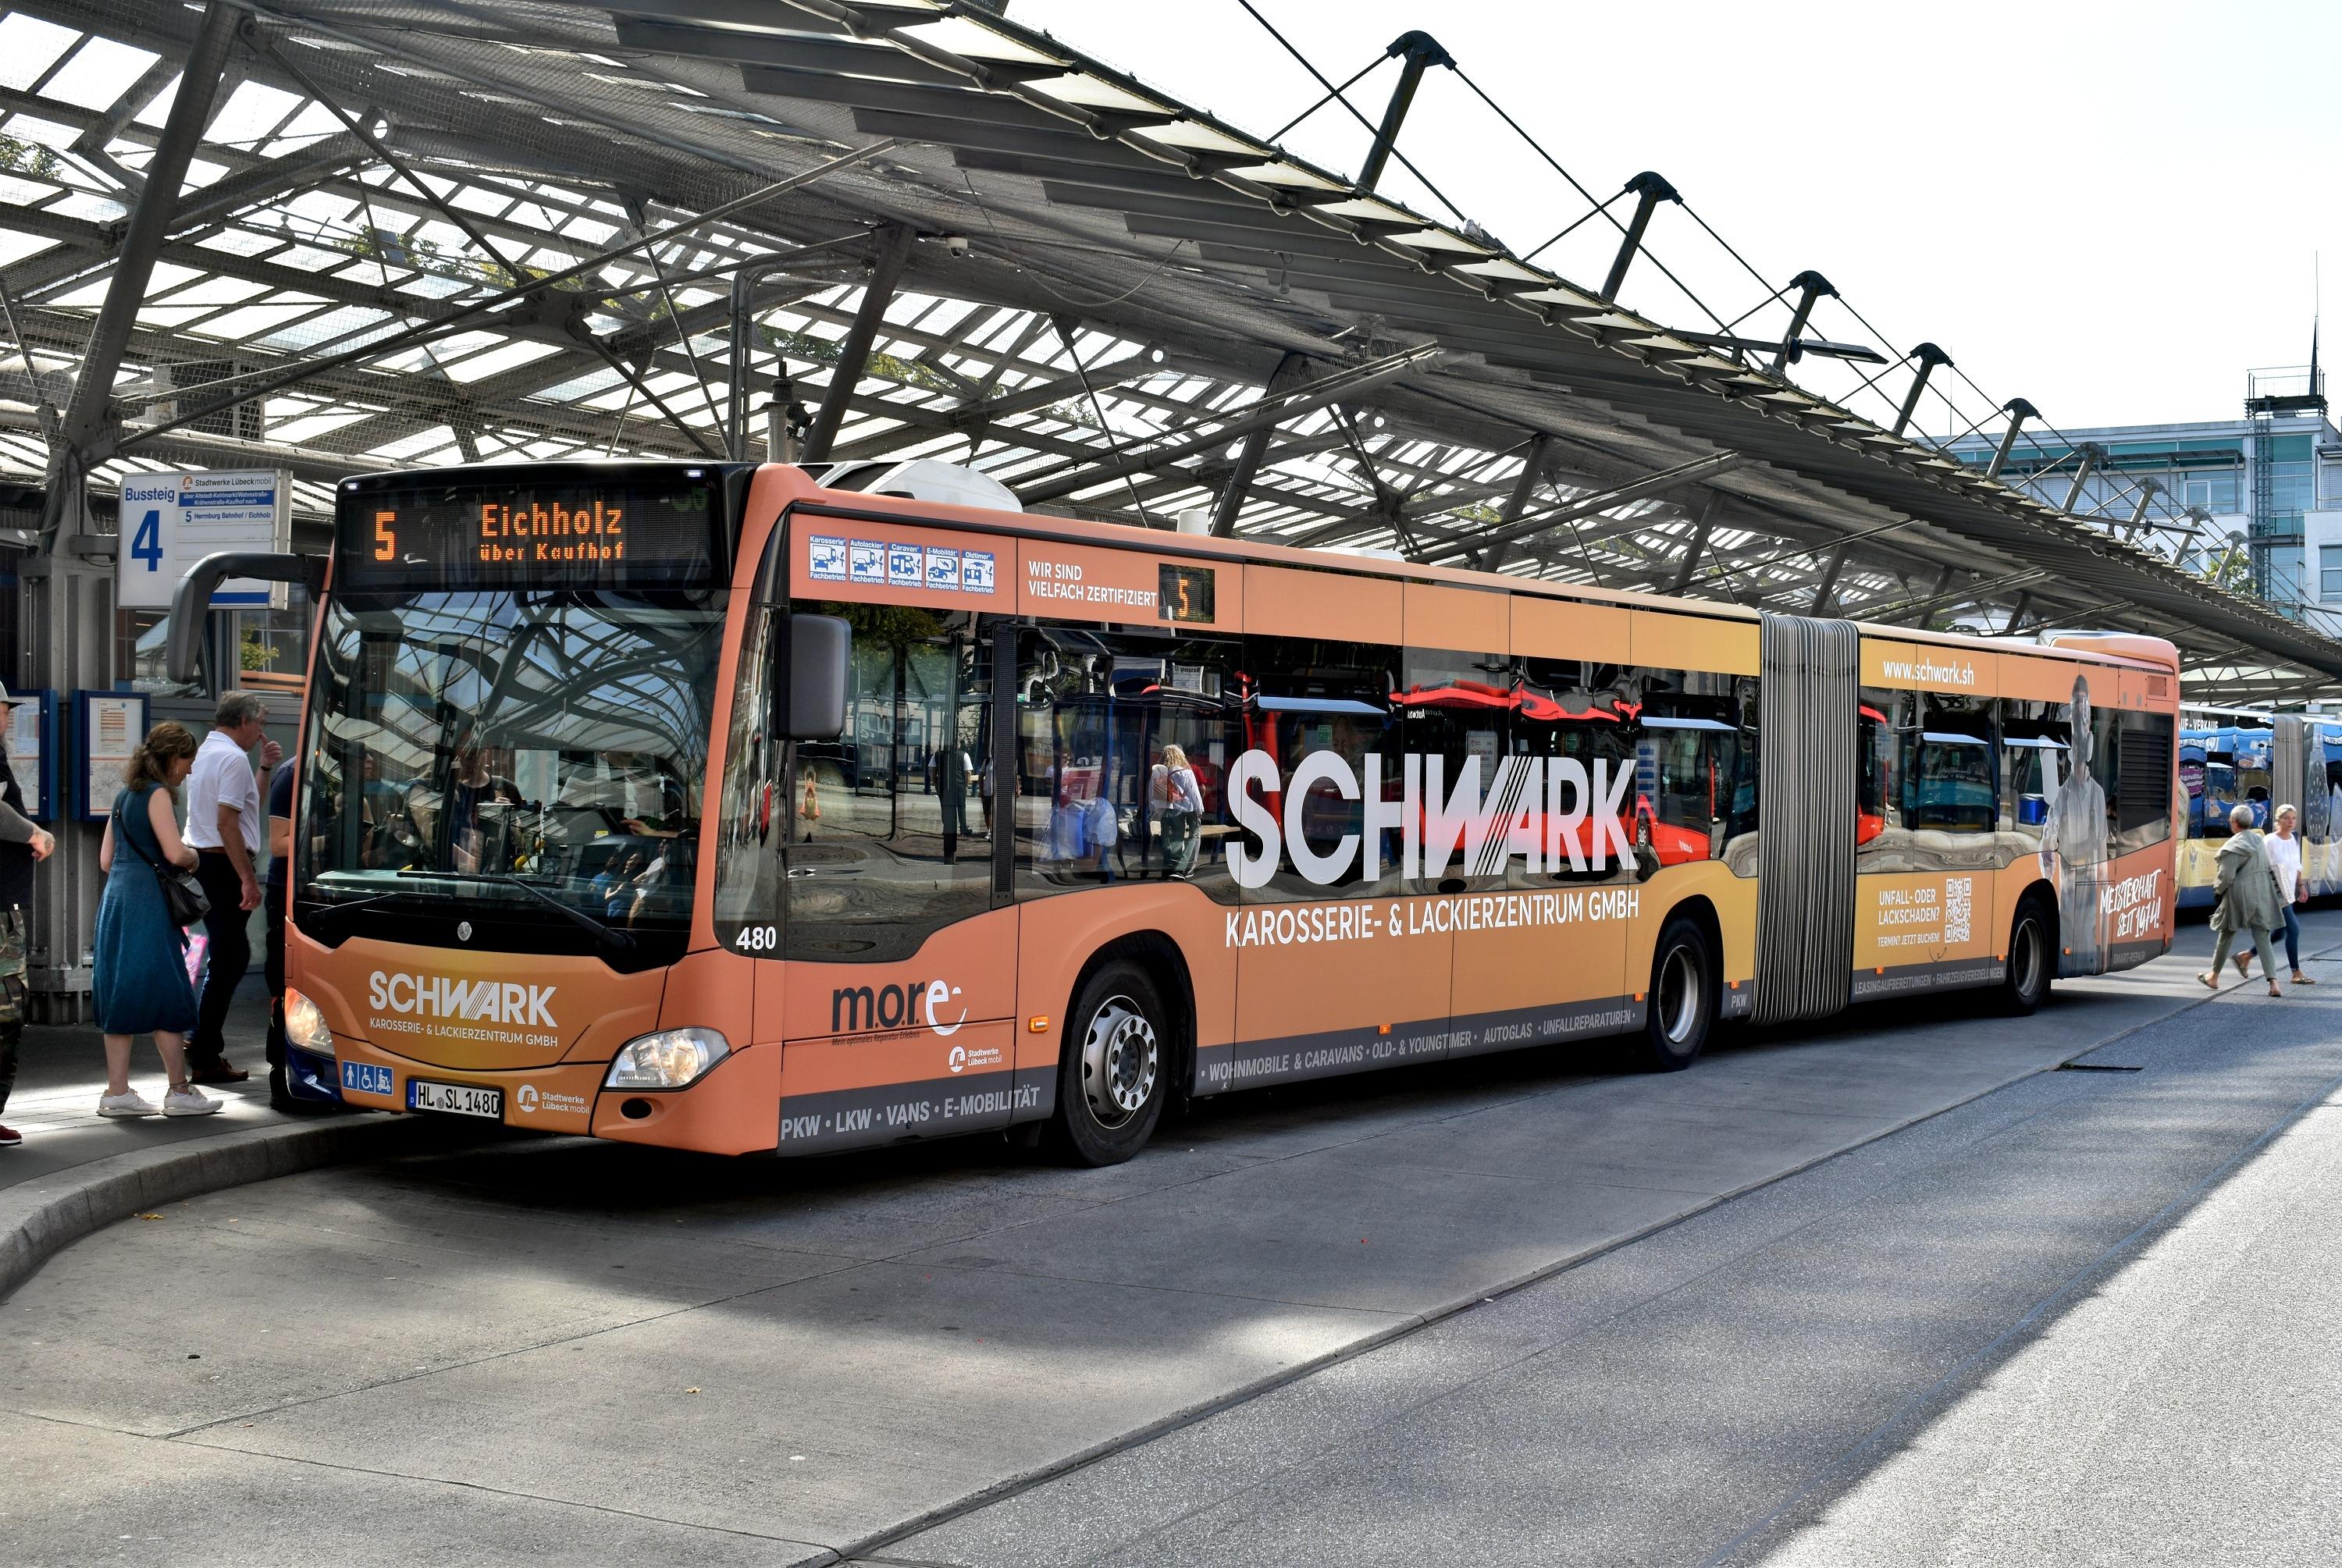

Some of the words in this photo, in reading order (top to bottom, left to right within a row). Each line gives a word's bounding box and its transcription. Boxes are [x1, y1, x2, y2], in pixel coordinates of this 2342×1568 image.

[195, 478, 230, 487] Stadtwerke
[231, 476, 254, 485] Lübeck
[125, 487, 175, 503] Bussteig
[186, 510, 192, 523] 5
[481, 500, 623, 537] Eichholz
[131, 510, 163, 571] 4
[375, 511, 396, 560] 5
[480, 544, 525, 561] über
[536, 542, 624, 561] Kaufhof
[810, 571, 846, 581] Fachbetrieb
[849, 575, 884, 584] Fachbetrieb
[1028, 560, 1052, 578] WIR
[1055, 563, 1082, 581] SIND
[1029, 581, 1084, 601] VIELFACH
[1087, 585, 1157, 607] ZERTIFIZIERT
[1177, 579, 1189, 617] 5
[1883, 658, 1974, 686] www.schwark.sh
[2193, 718, 2219, 734] VERKAUF
[1225, 748, 1639, 890] SCHWARK
[1879, 889, 1913, 905] UNFALL-
[1914, 887, 1936, 904] ODER
[2100, 868, 2162, 915] MEISTERHAFT
[1226, 903, 1383, 948] KAROSSERIE-
[1388, 904, 1403, 937] &
[1409, 891, 1583, 936] LACKIERZENTRUM
[1587, 889, 1639, 921] GMBH
[1878, 906, 1941, 926] LACKSCHADEN?
[2117, 908, 2137, 937] SEIT
[2135, 896, 2162, 938] 1974!
[735, 926, 777, 951] 480
[1877, 935, 1900, 948] TERMIN?
[1901, 933, 1917, 945] JETZT
[1917, 932, 1941, 944] BUCHEN!
[1855, 973, 1931, 995] LEASINGAUFBEREITUNGEN
[368, 969, 559, 1027] SCHWARK
[1731, 994, 1747, 1008] PKW
[369, 1018, 424, 1036] KAROSSERIE-
[426, 1025, 434, 1036] &
[436, 1025, 524, 1044] LACKIERZENTRUM
[525, 1033, 559, 1047] GMBH
[832, 1037, 846, 1046] Mein
[846, 1035, 873, 1047] optimales
[874, 1033, 899, 1043] Reparatur
[899, 1030, 920, 1040] Erlebnis
[968, 1047, 999, 1058] Stadtwerke
[1209, 1054, 1290, 1082] WOHNMOBILE
[1294, 1054, 1302, 1071] &
[1304, 1044, 1364, 1069] CARAVANS
[1372, 1041, 1396, 1060] OLD-
[1398, 1039, 1407, 1055] &
[1408, 1030, 1472, 1054] YOUNGTIMER
[1483, 1022, 1533, 1044] AUTOGLAS
[1543, 1008, 1631, 1036] UNFALLREPARATUREN
[968, 1055, 988, 1066] Lübeck
[988, 1054, 1002, 1065] mobil
[418, 1085, 434, 1107] HL
[445, 1088, 462, 1111] SL
[465, 1091, 500, 1115] 1480
[542, 1092, 585, 1104] Stadtwerke
[542, 1101, 569, 1111] Lübeck
[570, 1105, 589, 1115] mobil
[781, 1115, 821, 1140] PKW
[835, 1108, 872, 1133] LKW
[885, 1100, 930, 1126] VANS
[944, 1084, 1041, 1118] E-MOBILITÄT
